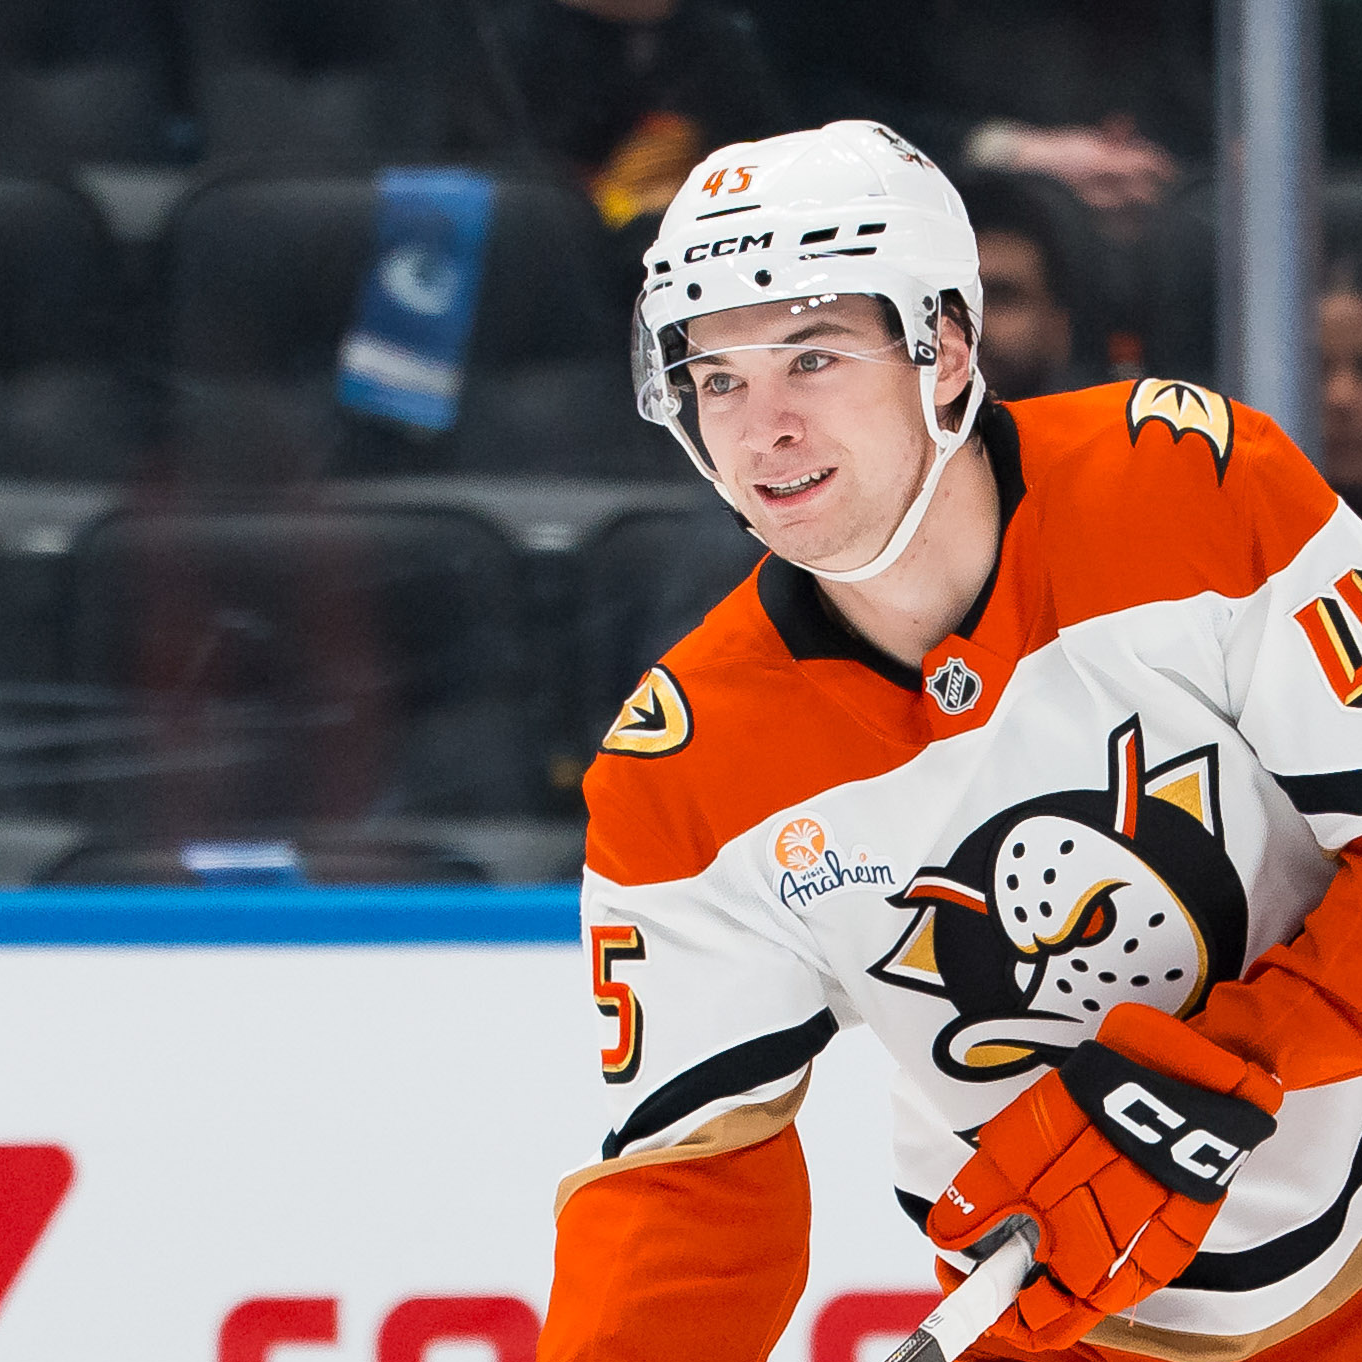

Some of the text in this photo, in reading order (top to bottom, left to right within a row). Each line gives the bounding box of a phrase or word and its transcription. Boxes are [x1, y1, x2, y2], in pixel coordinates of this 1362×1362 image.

[701, 165, 760, 198] 45
[683, 231, 774, 265] CCM
[948, 671, 964, 707] NHL
[780, 849, 897, 911] Anaheim
[800, 866, 827, 882] visit
[946, 1184, 976, 1216] CM
